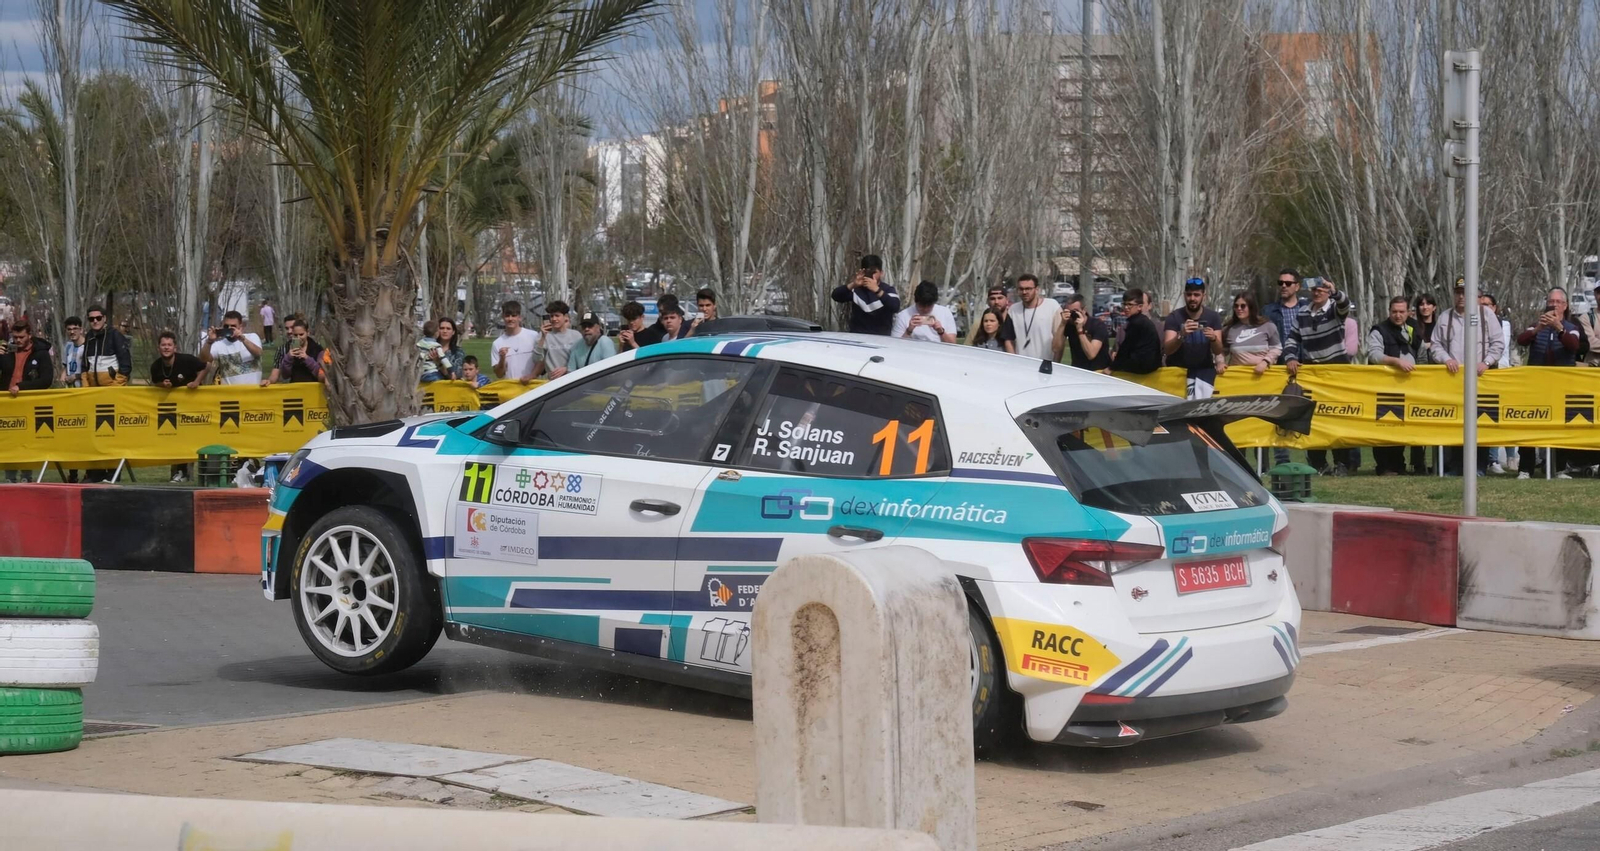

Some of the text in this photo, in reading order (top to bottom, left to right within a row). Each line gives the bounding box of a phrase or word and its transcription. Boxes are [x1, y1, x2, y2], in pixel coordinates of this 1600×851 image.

[1316, 404, 1361, 415] Recalvi
[1410, 406, 1456, 418] Recalvi
[1505, 408, 1549, 419] Recalvi
[57, 416, 86, 427] Recalvi
[118, 415, 148, 425] Recalvi
[180, 414, 210, 424] Recalvi
[243, 412, 272, 422] Recalvi
[757, 419, 844, 444] J. Solans
[752, 438, 855, 466] R. Sanjuan
[872, 418, 935, 476] 11
[958, 451, 1024, 467] RACESEVEN
[464, 462, 494, 504] 11
[495, 487, 555, 508] CÓRDOBA
[558, 494, 592, 504] PATRIMONIO
[1190, 492, 1228, 505] KTVA
[558, 502, 596, 512] HUMANIDAD
[840, 496, 1008, 524] dexinformática
[490, 514, 526, 526] Diputación
[490, 524, 526, 535] de Córdoba
[1209, 528, 1269, 548] dexinformática
[1180, 562, 1245, 586] S 5635 BCH
[738, 584, 761, 594] FEDE
[1031, 630, 1084, 656] RACC
[1021, 653, 1090, 681] PIRELLI
